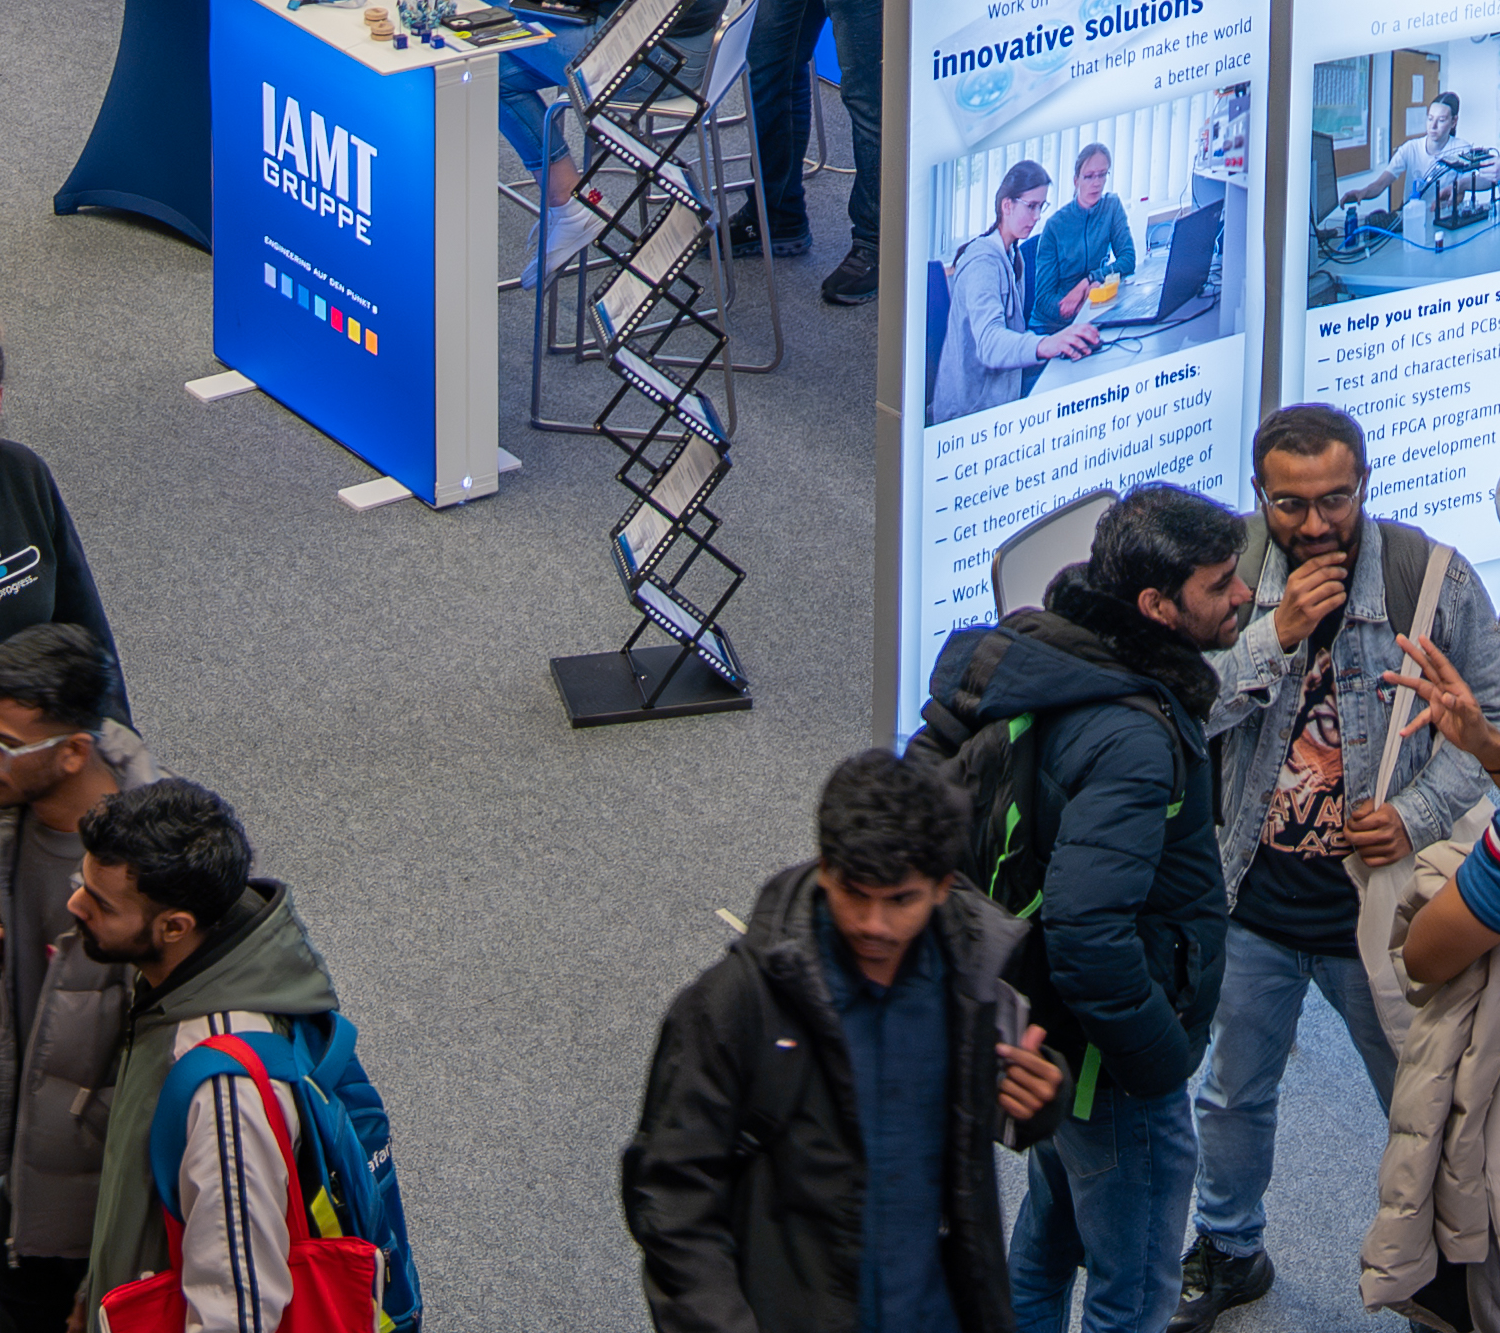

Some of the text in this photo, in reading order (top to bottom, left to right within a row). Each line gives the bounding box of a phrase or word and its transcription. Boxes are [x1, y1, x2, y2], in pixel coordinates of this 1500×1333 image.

[933, 24, 1074, 80] innovative
[1070, 16, 1253, 79] that help make the world
[263, 81, 378, 216] IAMT
[263, 156, 373, 247] GRUPPE
[1056, 362, 1201, 419] internship thesis:
